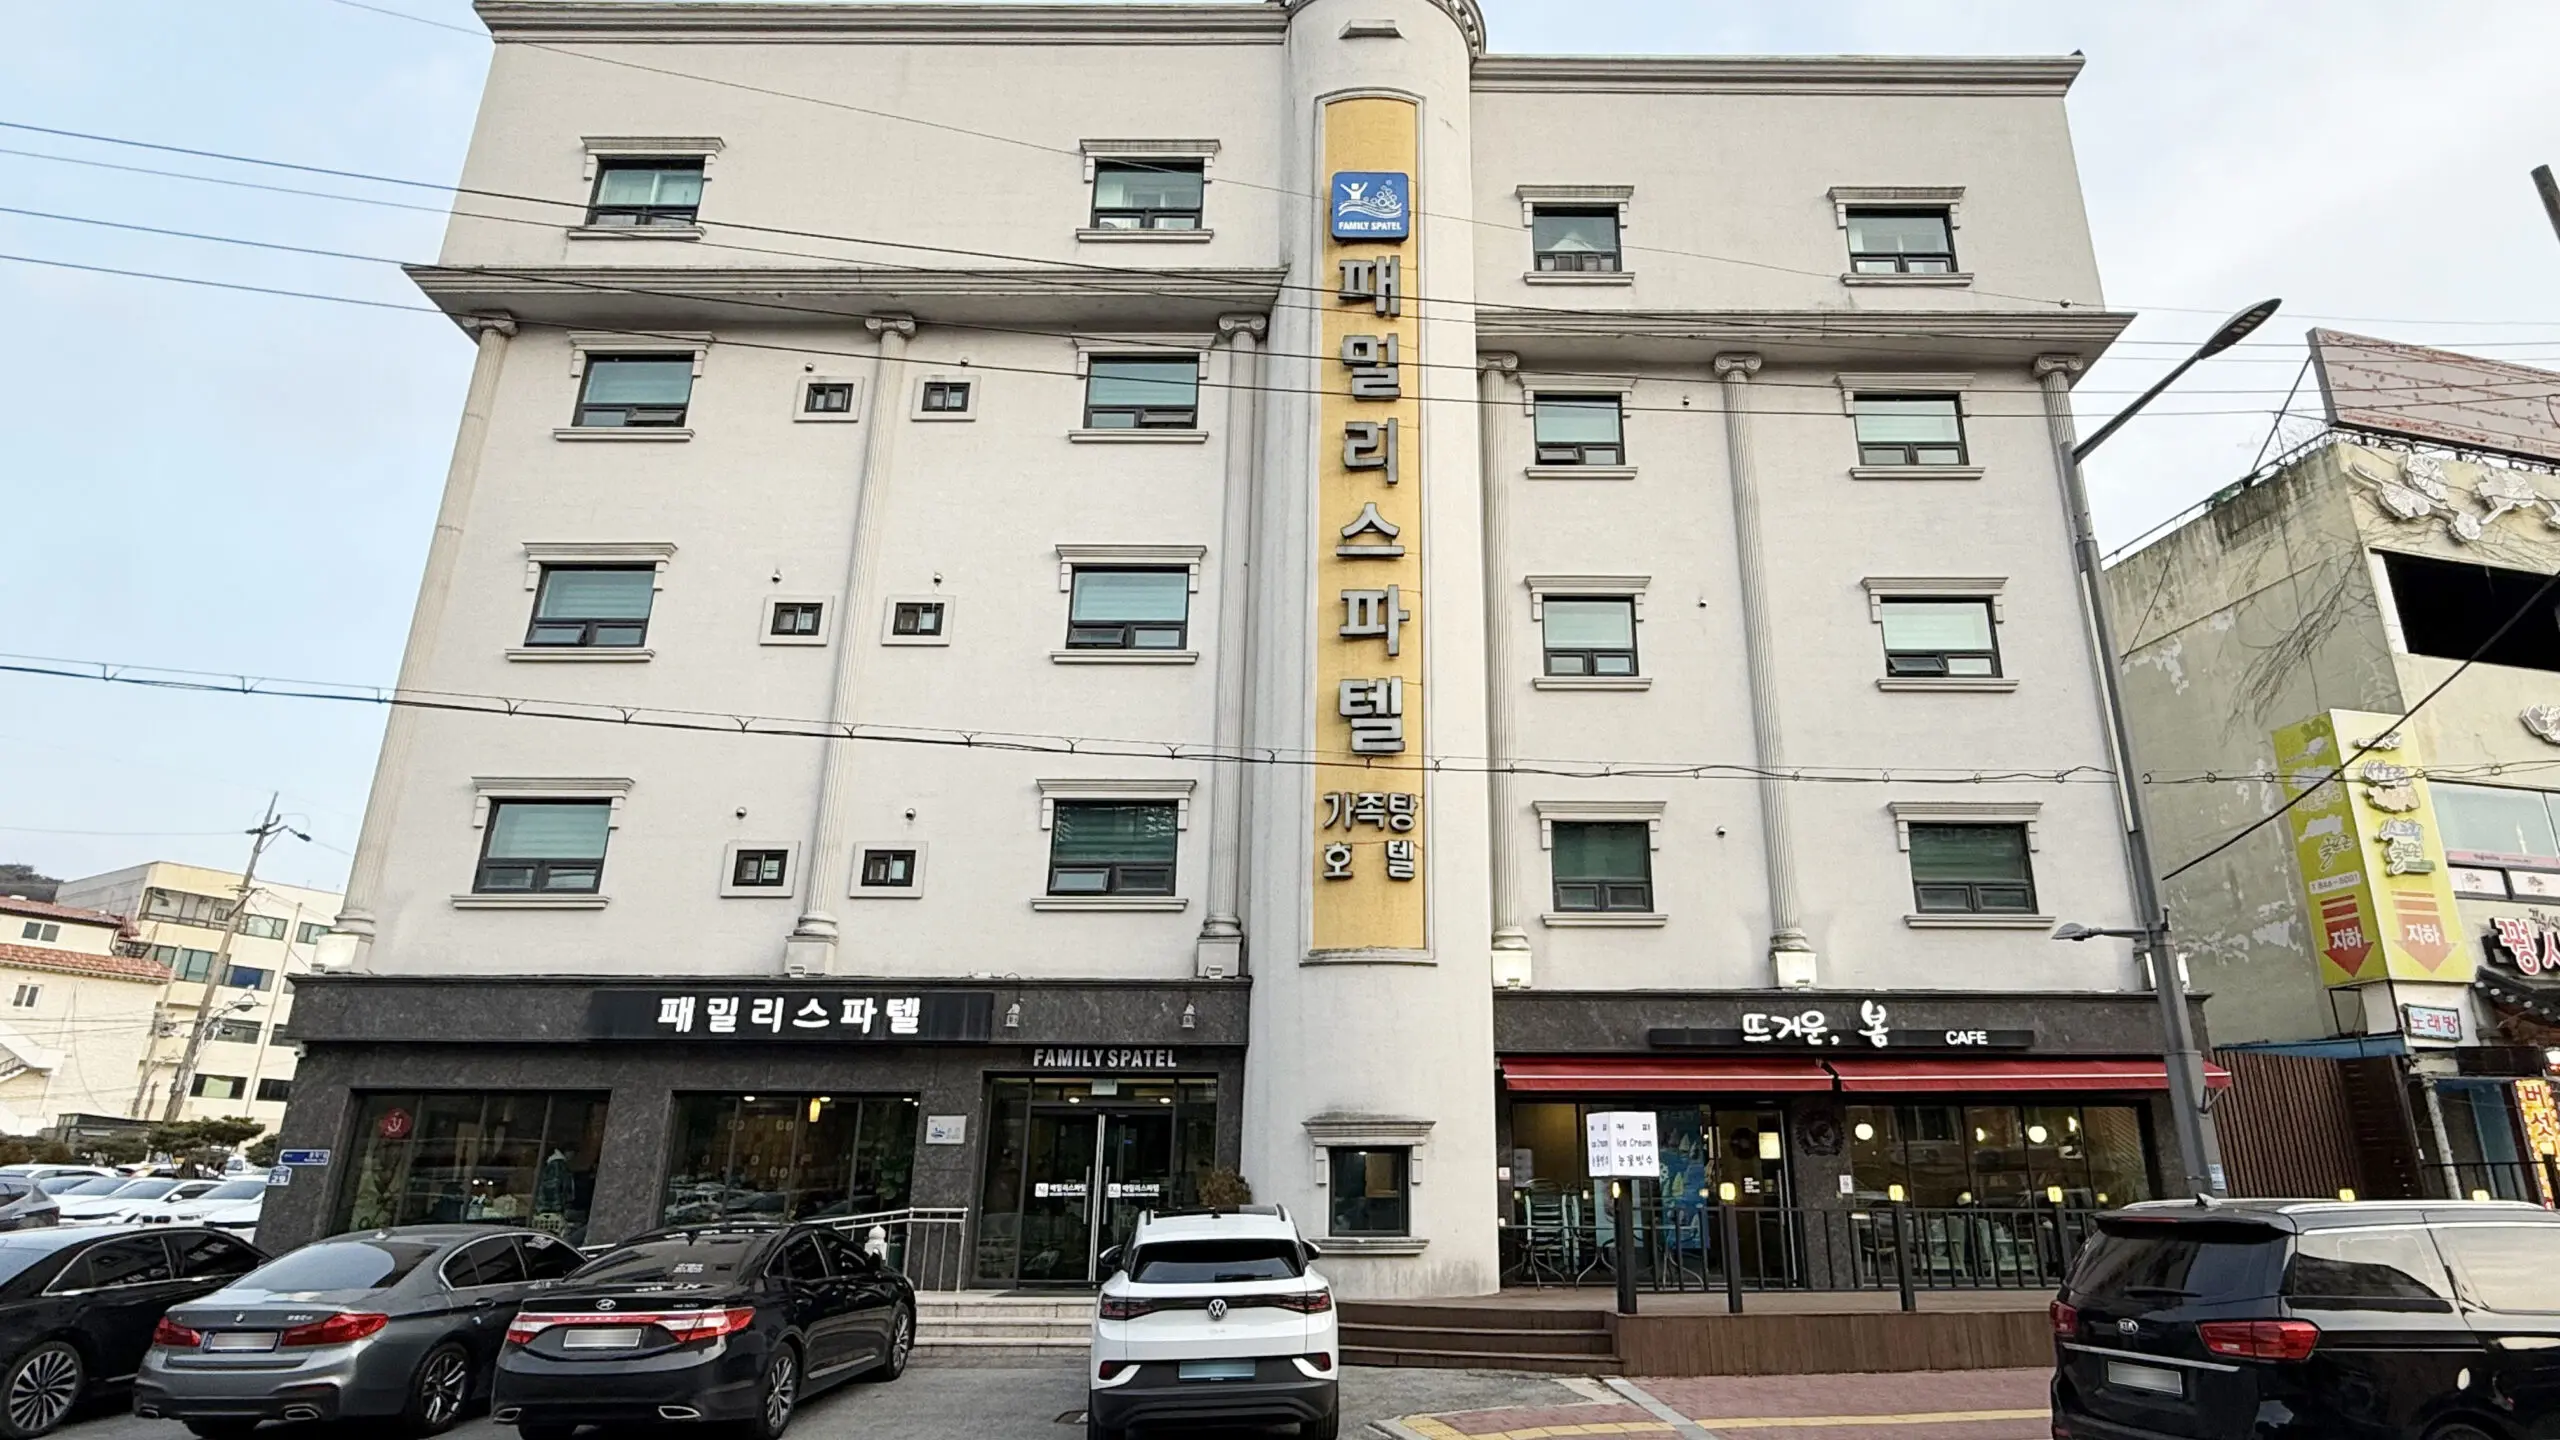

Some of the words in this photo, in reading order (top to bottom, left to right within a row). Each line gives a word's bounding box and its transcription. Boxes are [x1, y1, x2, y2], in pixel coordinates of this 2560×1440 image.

[1338, 221, 1369, 230] FAMILY
[1370, 221, 1402, 230] SPATEL
[1336, 254, 1410, 753] 패밀리스파텔
[1322, 792, 1418, 832] 가족탕
[2330, 926, 2362, 951] 지하
[2405, 923, 2441, 946] 지하
[657, 996, 922, 1035] 패밀리스파텔
[1743, 1010, 1840, 1046] 뜨거운,
[1858, 1000, 1889, 1048] 봄
[1946, 1030, 1989, 1046] CAFE
[1033, 1048, 1104, 1068] FAMILY
[1107, 1048, 1178, 1068] SPATEL
[1616, 1138, 1627, 1147] Ice
[1630, 1138, 1653, 1148] Cream
